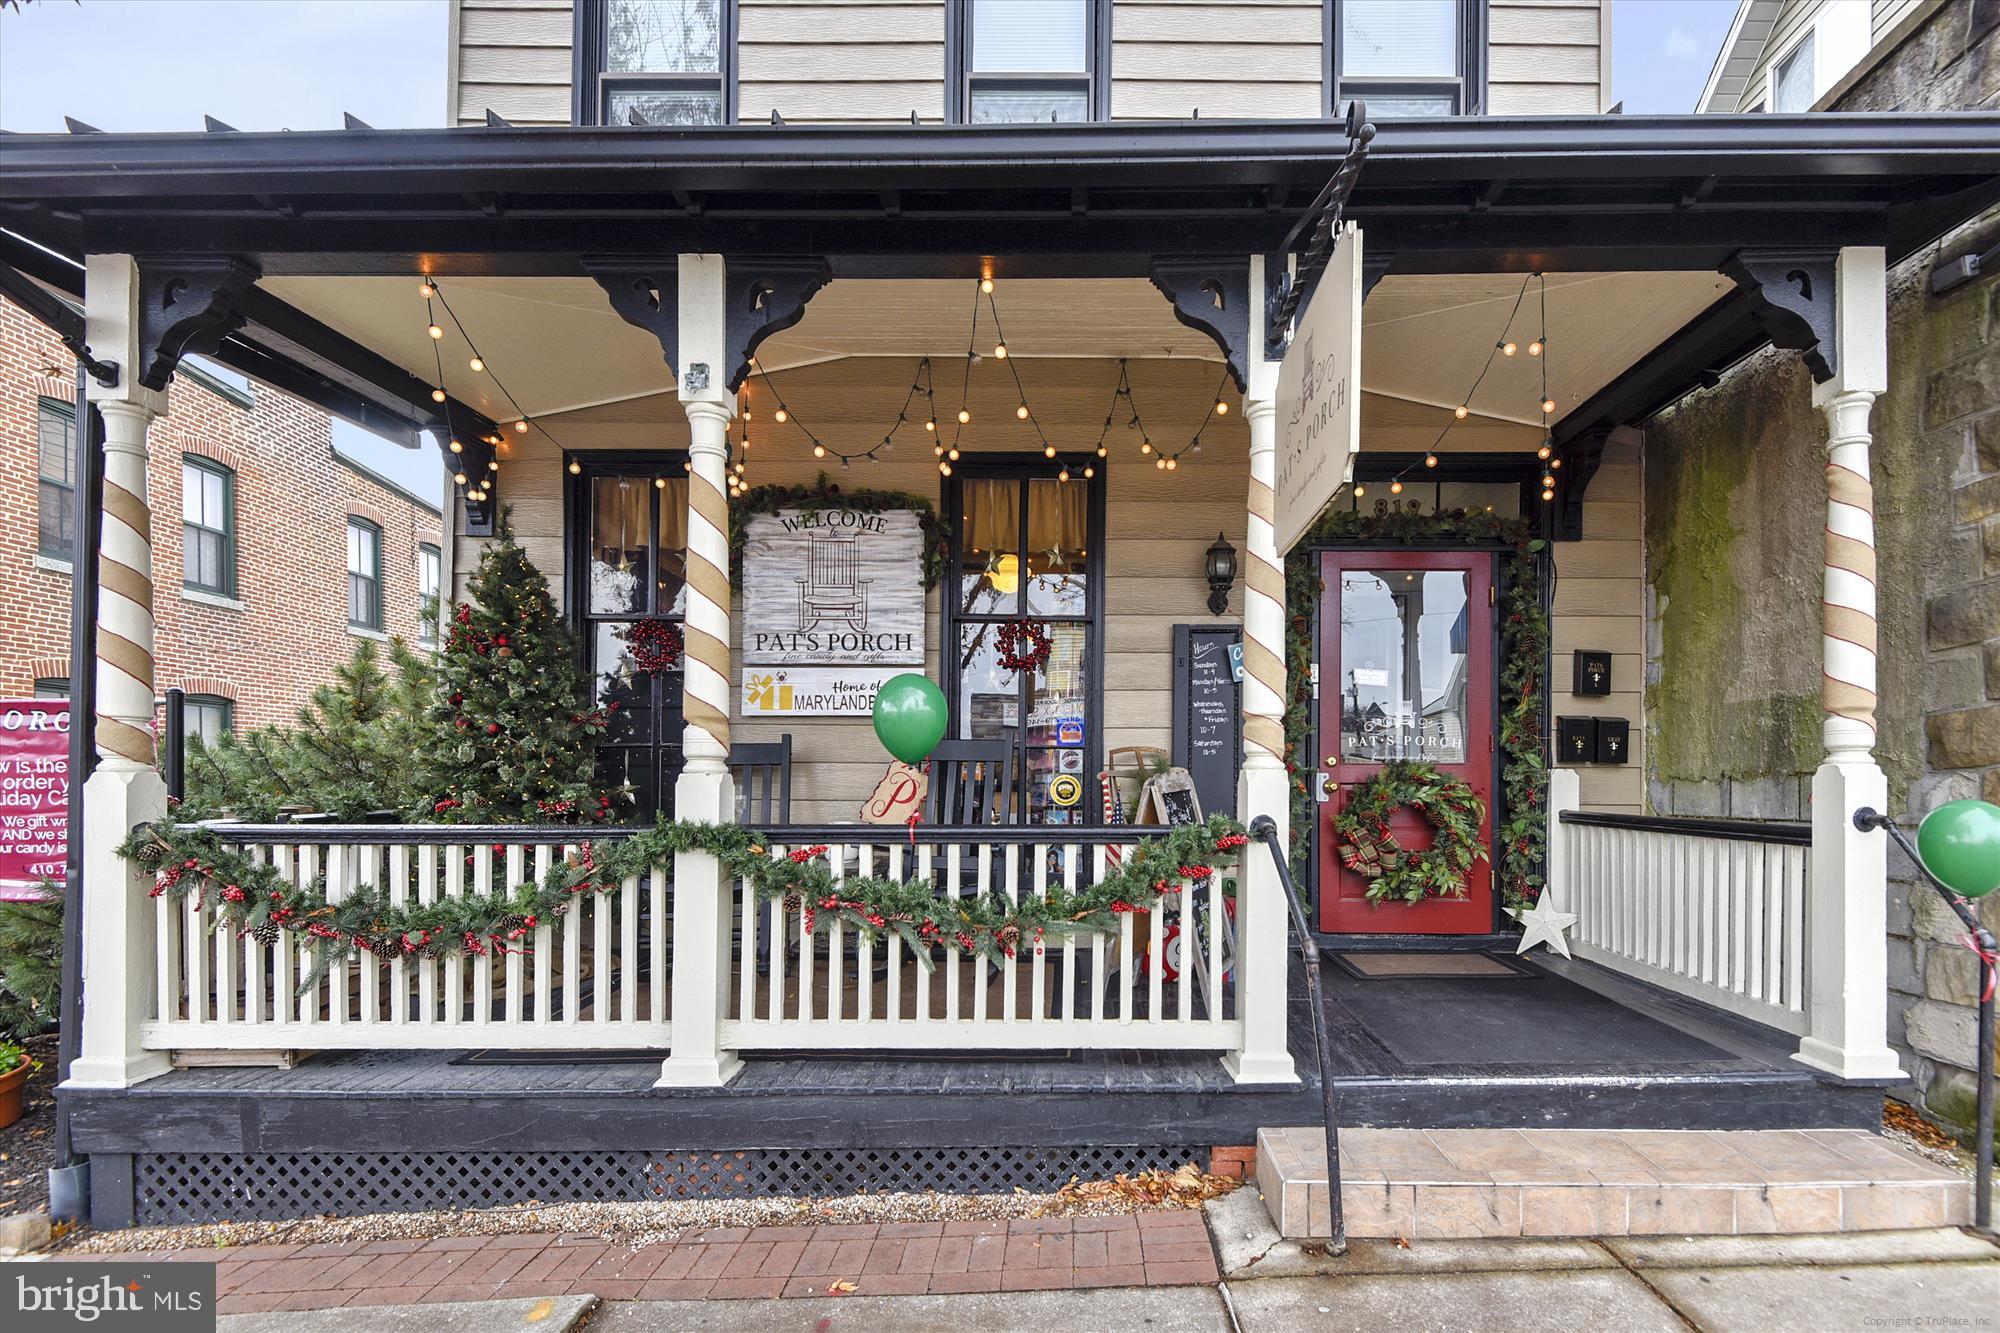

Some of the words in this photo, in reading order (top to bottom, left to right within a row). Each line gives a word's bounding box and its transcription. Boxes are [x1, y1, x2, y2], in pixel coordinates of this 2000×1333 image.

[1306, 378, 1345, 450] PORCH
[1374, 499, 1421, 518] 819
[780, 510, 888, 534] WELCOME
[829, 526, 840, 538] to
[755, 633, 819, 651] PAT'S
[823, 633, 913, 651] PORCH
[1193, 641, 1215, 655] Hours
[783, 652, 801, 662] fine
[806, 652, 836, 661] candy
[840, 651, 861, 660] and
[863, 651, 886, 663] gifts
[832, 680, 868, 694] Home
[869, 680, 882, 693] of
[1200, 725, 1217, 734] 10-7
[1404, 735, 1463, 749] PORCH
[16, 758, 31, 774] is
[35, 758, 68, 774] the
[3, 774, 56, 790] order
[0, 790, 43, 810] iday
[871, 772, 920, 818] P
[1, 816, 25, 828] We
[27, 815, 49, 830] gift
[2, 829, 33, 841] AND
[35, 831, 56, 840] we
[16, 842, 56, 857] candy
[57, 842, 68, 853] is
